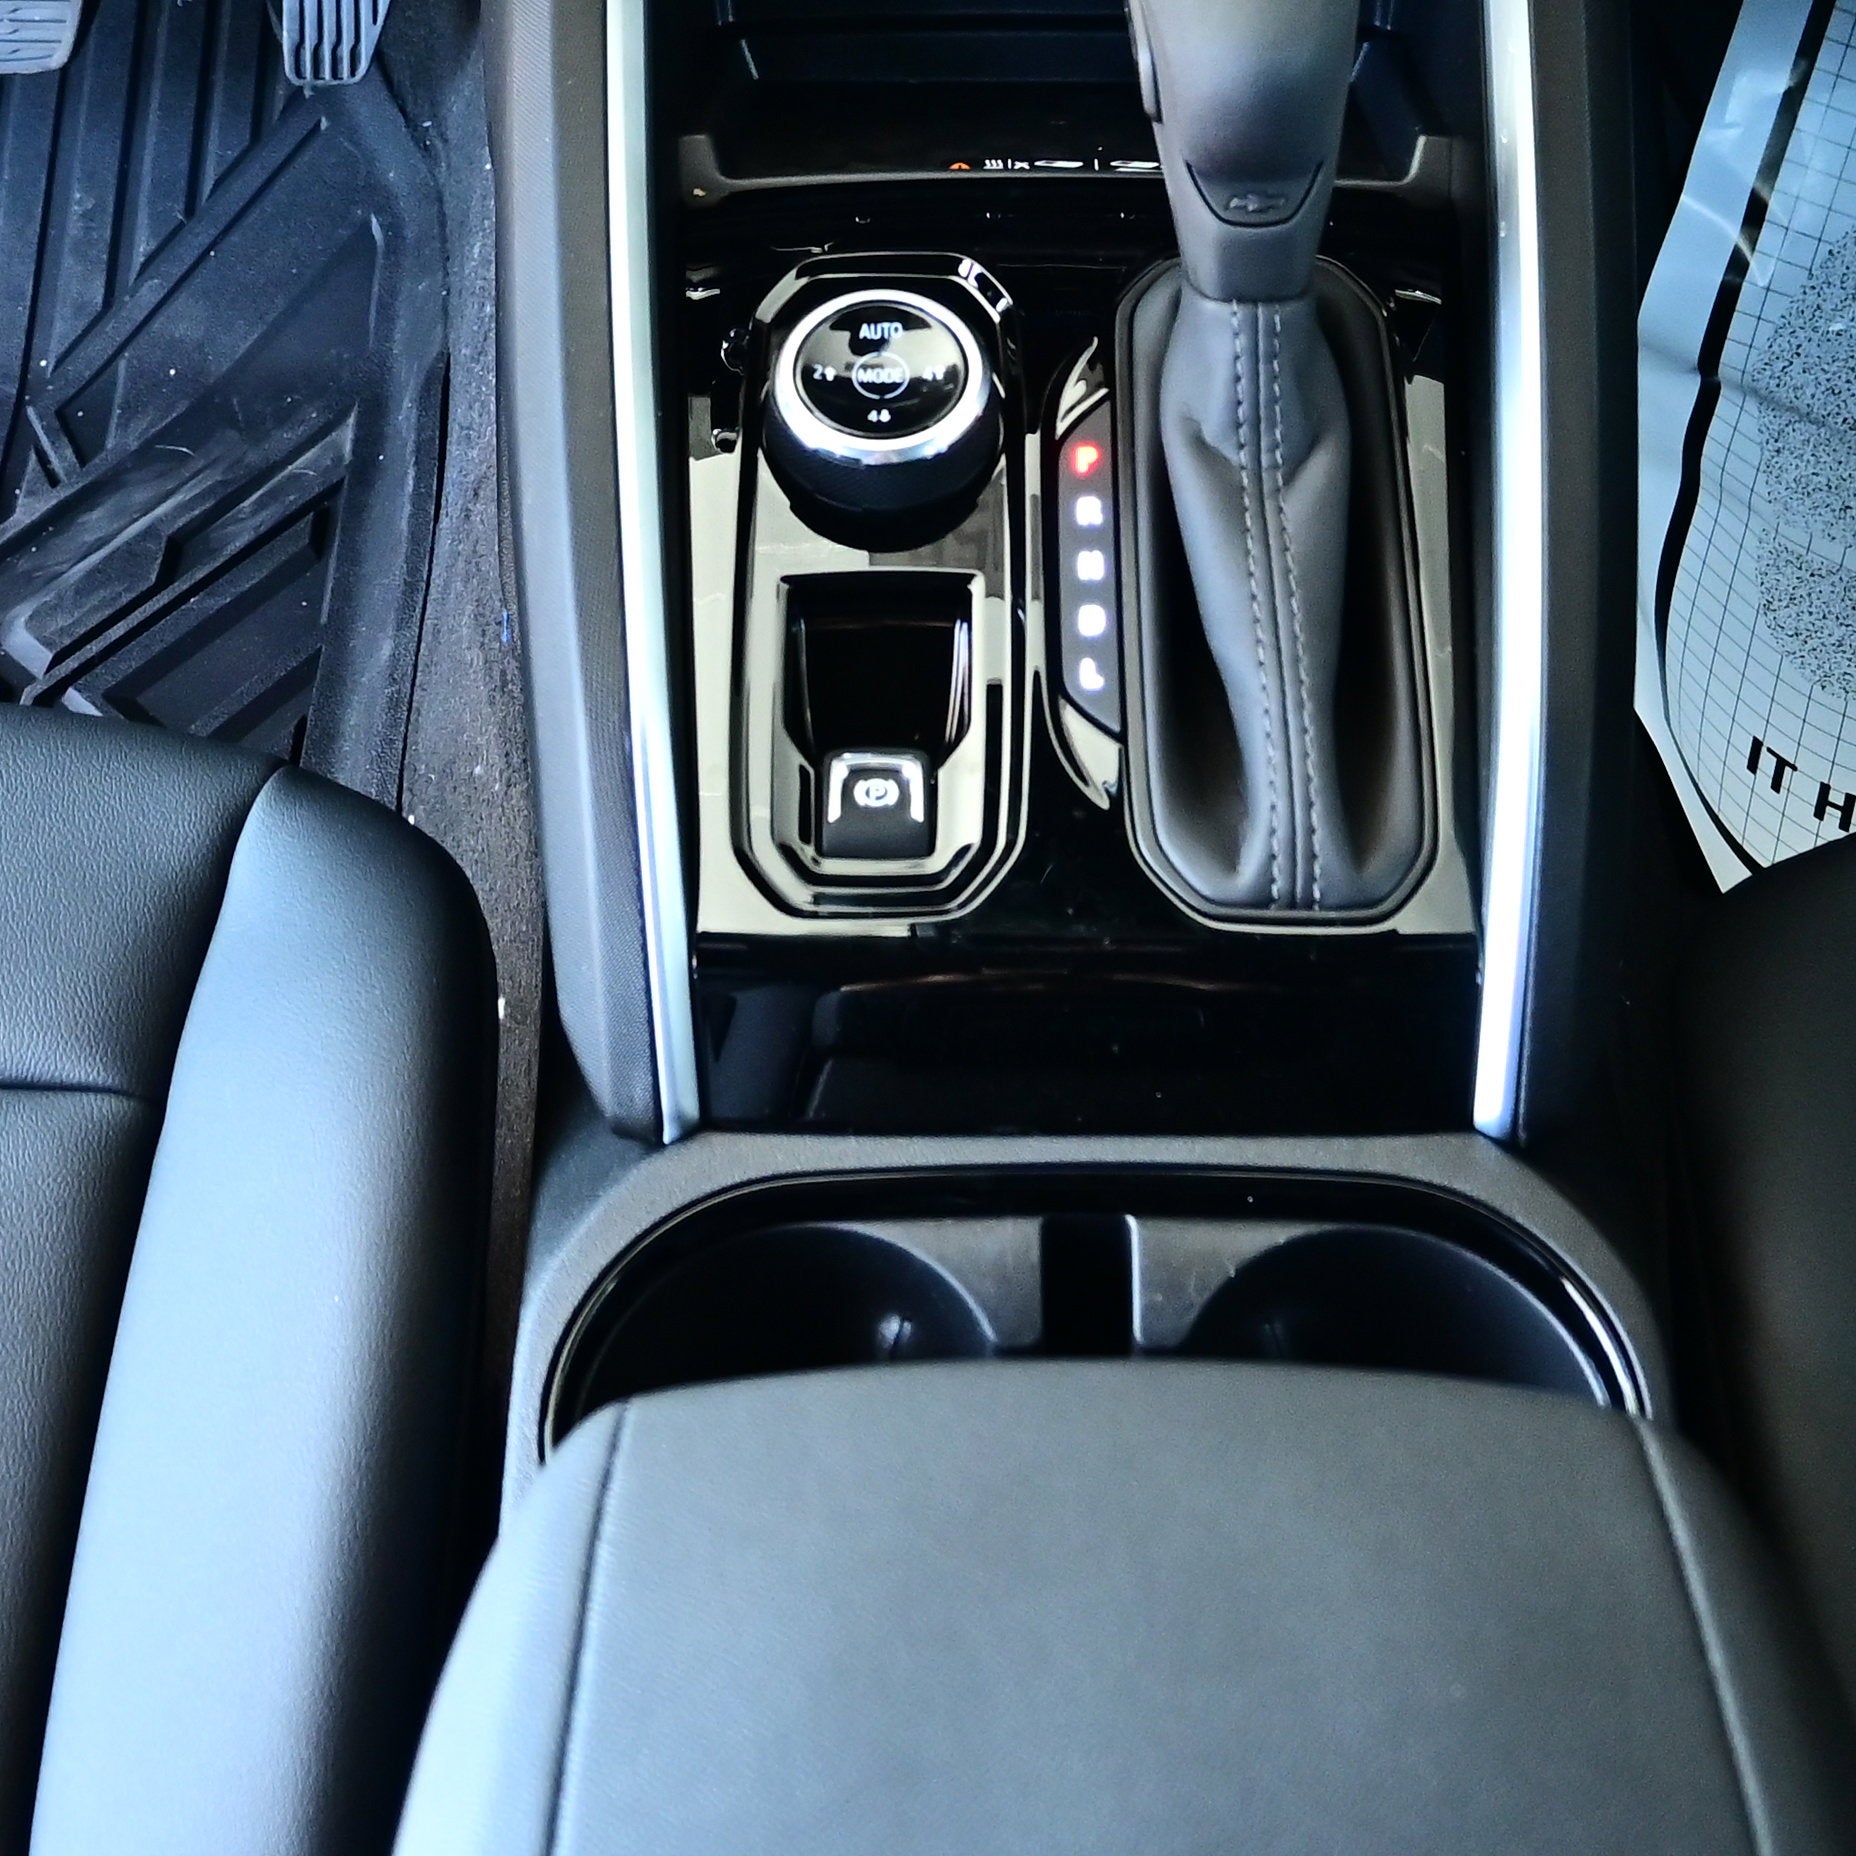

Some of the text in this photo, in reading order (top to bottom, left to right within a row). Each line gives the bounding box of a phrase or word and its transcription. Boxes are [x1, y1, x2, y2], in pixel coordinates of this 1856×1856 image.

[859, 322, 904, 340] AUTO
[857, 367, 905, 384] MODE
[1075, 444, 1098, 473] P
[1075, 496, 1103, 526] R
[1077, 604, 1105, 637] D
[1079, 657, 1104, 692] L
[1746, 735, 1798, 795] IT
